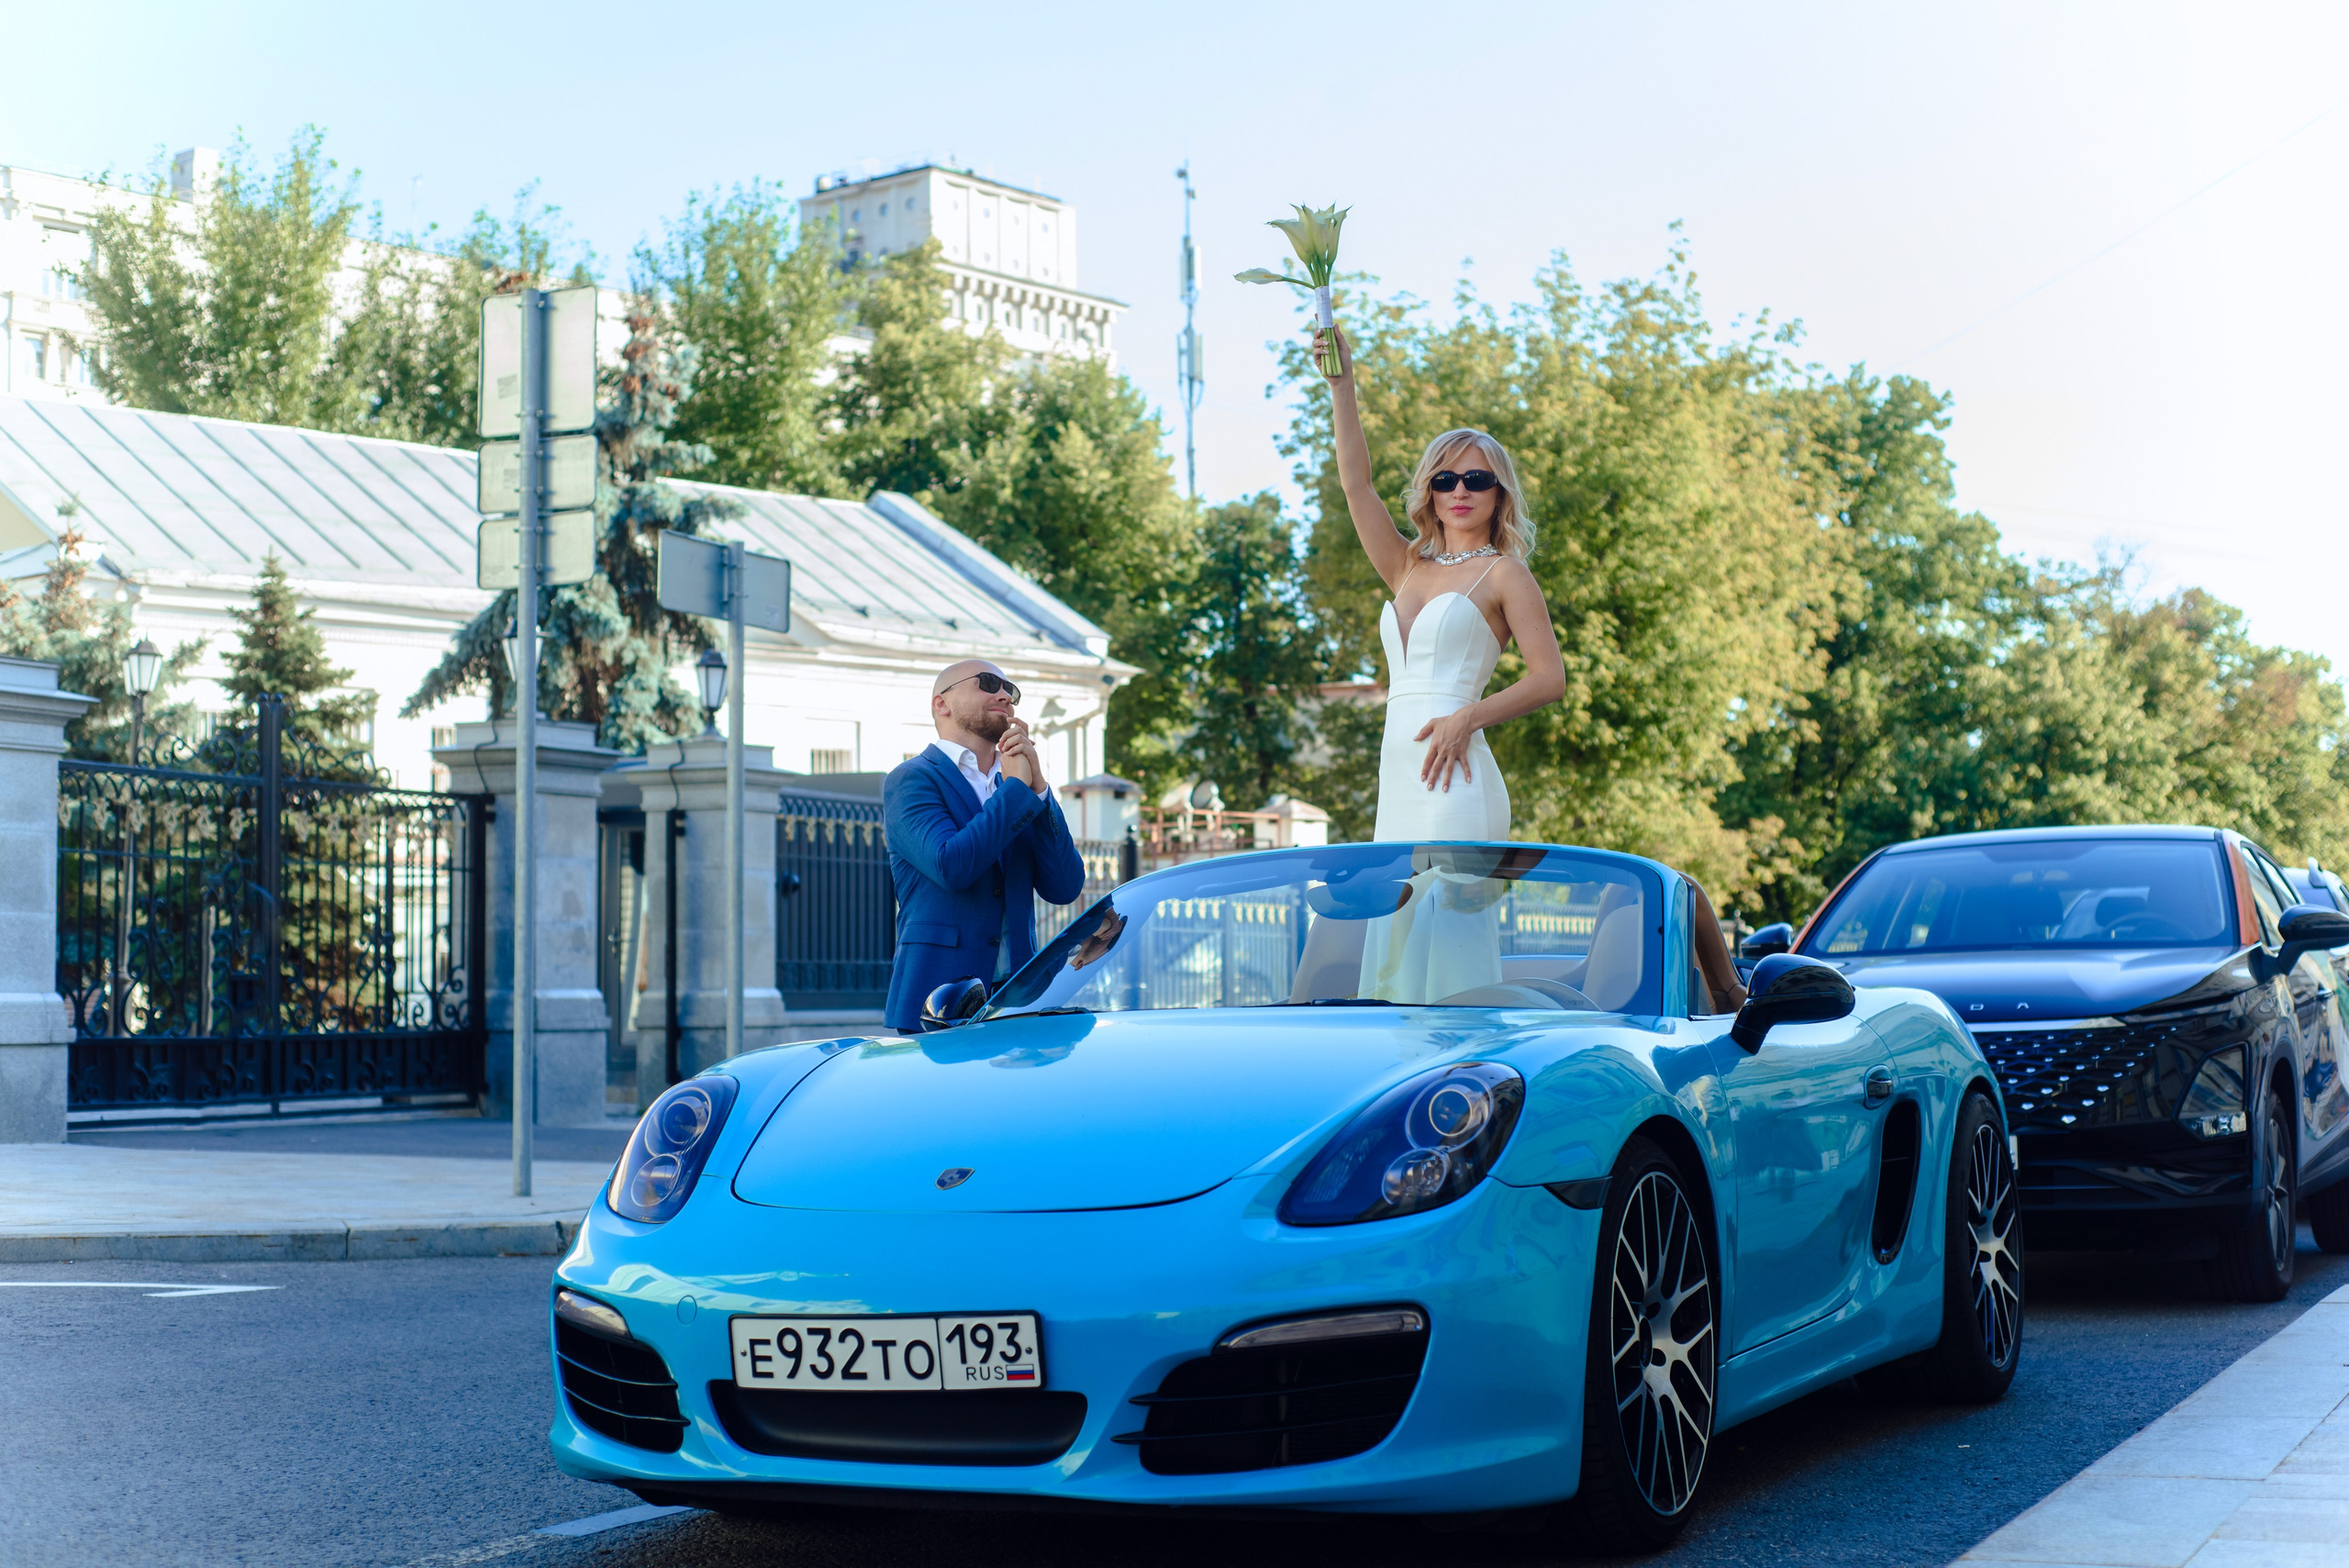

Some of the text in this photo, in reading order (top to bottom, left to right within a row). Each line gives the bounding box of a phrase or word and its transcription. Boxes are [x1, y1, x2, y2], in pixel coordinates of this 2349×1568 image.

[749, 1321, 1023, 1381] E932TO 193
[965, 1365, 1005, 1382] RUS
